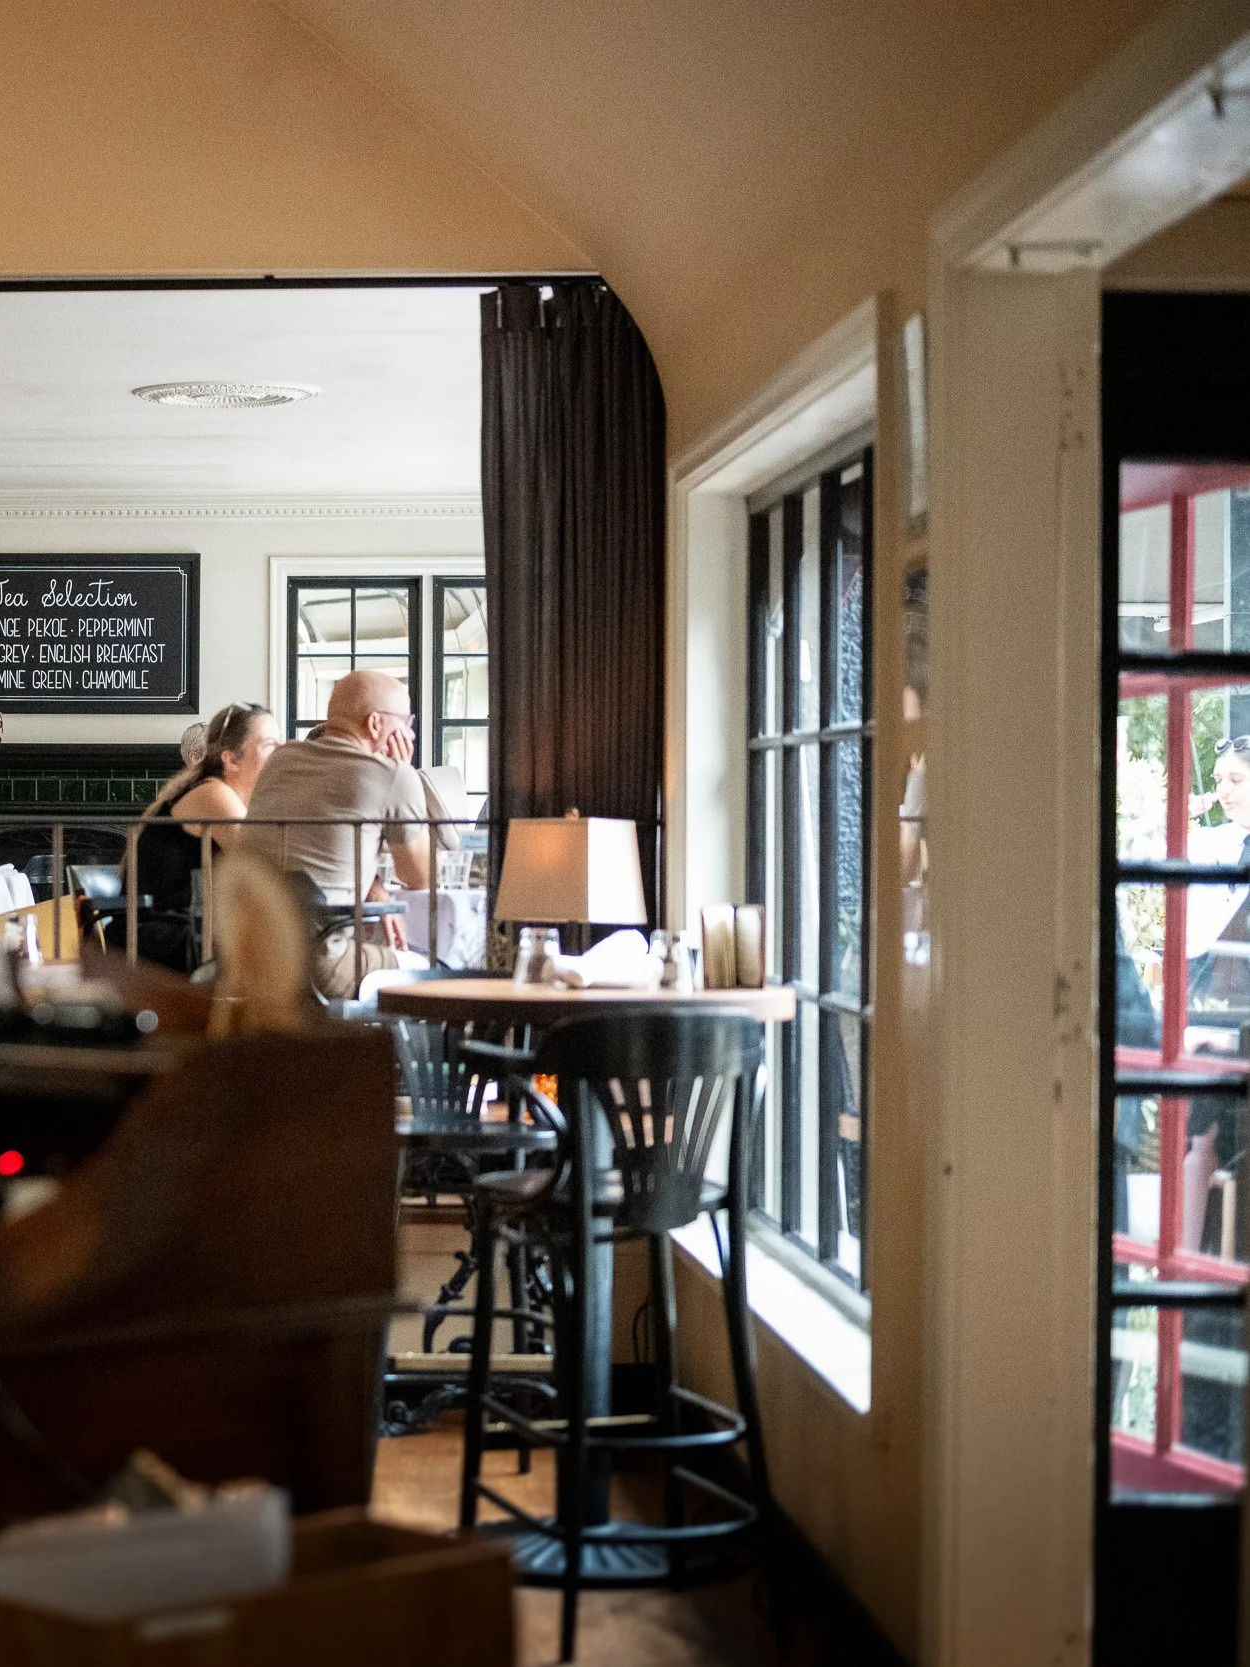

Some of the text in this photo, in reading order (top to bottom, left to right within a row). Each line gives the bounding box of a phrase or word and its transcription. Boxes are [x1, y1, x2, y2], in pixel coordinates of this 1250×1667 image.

[41, 578, 138, 607] Selection
[27, 617, 68, 638] PEKOE
[78, 617, 155, 638] PEPPERMINT
[39, 643, 91, 664] ENGLISH
[96, 643, 166, 664] BREAKFAST
[32, 669, 72, 690] GREEN
[81, 669, 150, 690] CHAMOMILE
